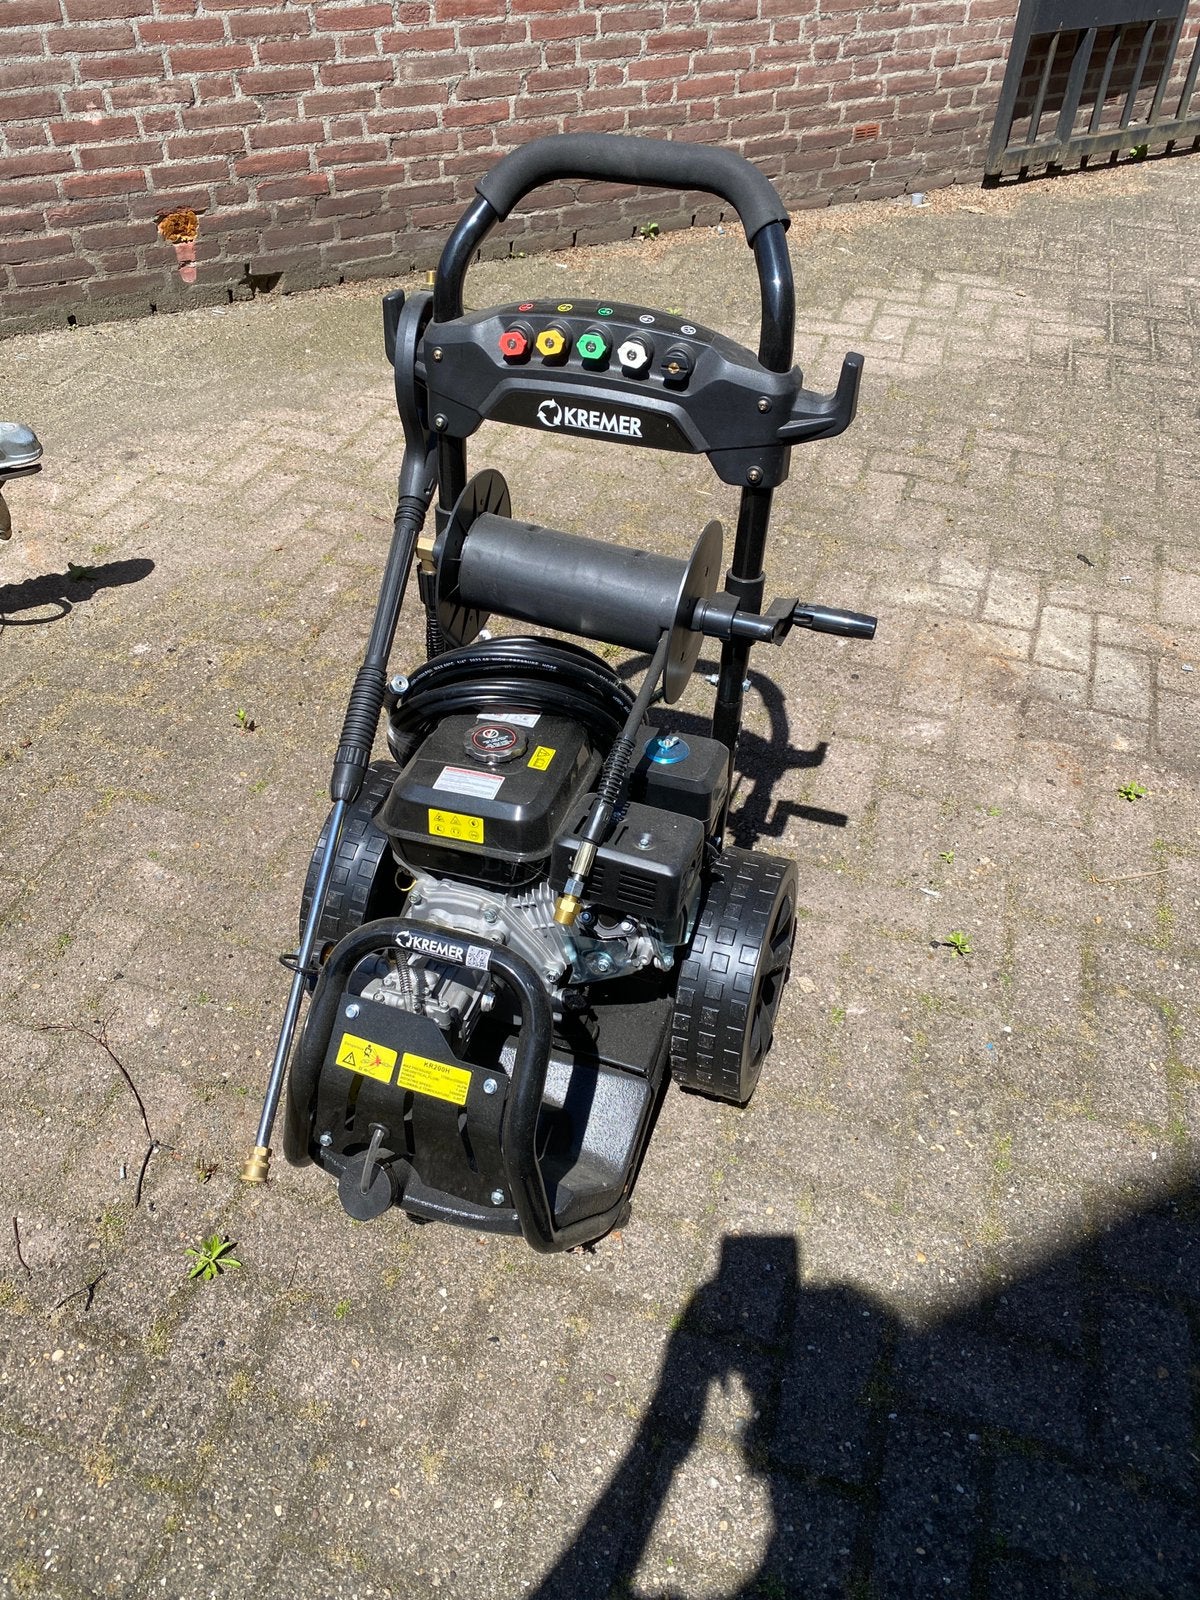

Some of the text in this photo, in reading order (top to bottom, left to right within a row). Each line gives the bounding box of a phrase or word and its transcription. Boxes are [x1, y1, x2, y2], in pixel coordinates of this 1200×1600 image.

[565, 407, 642, 437] KREMER
[413, 936, 464, 961] KREMER
[424, 1062, 450, 1074] KR200H
